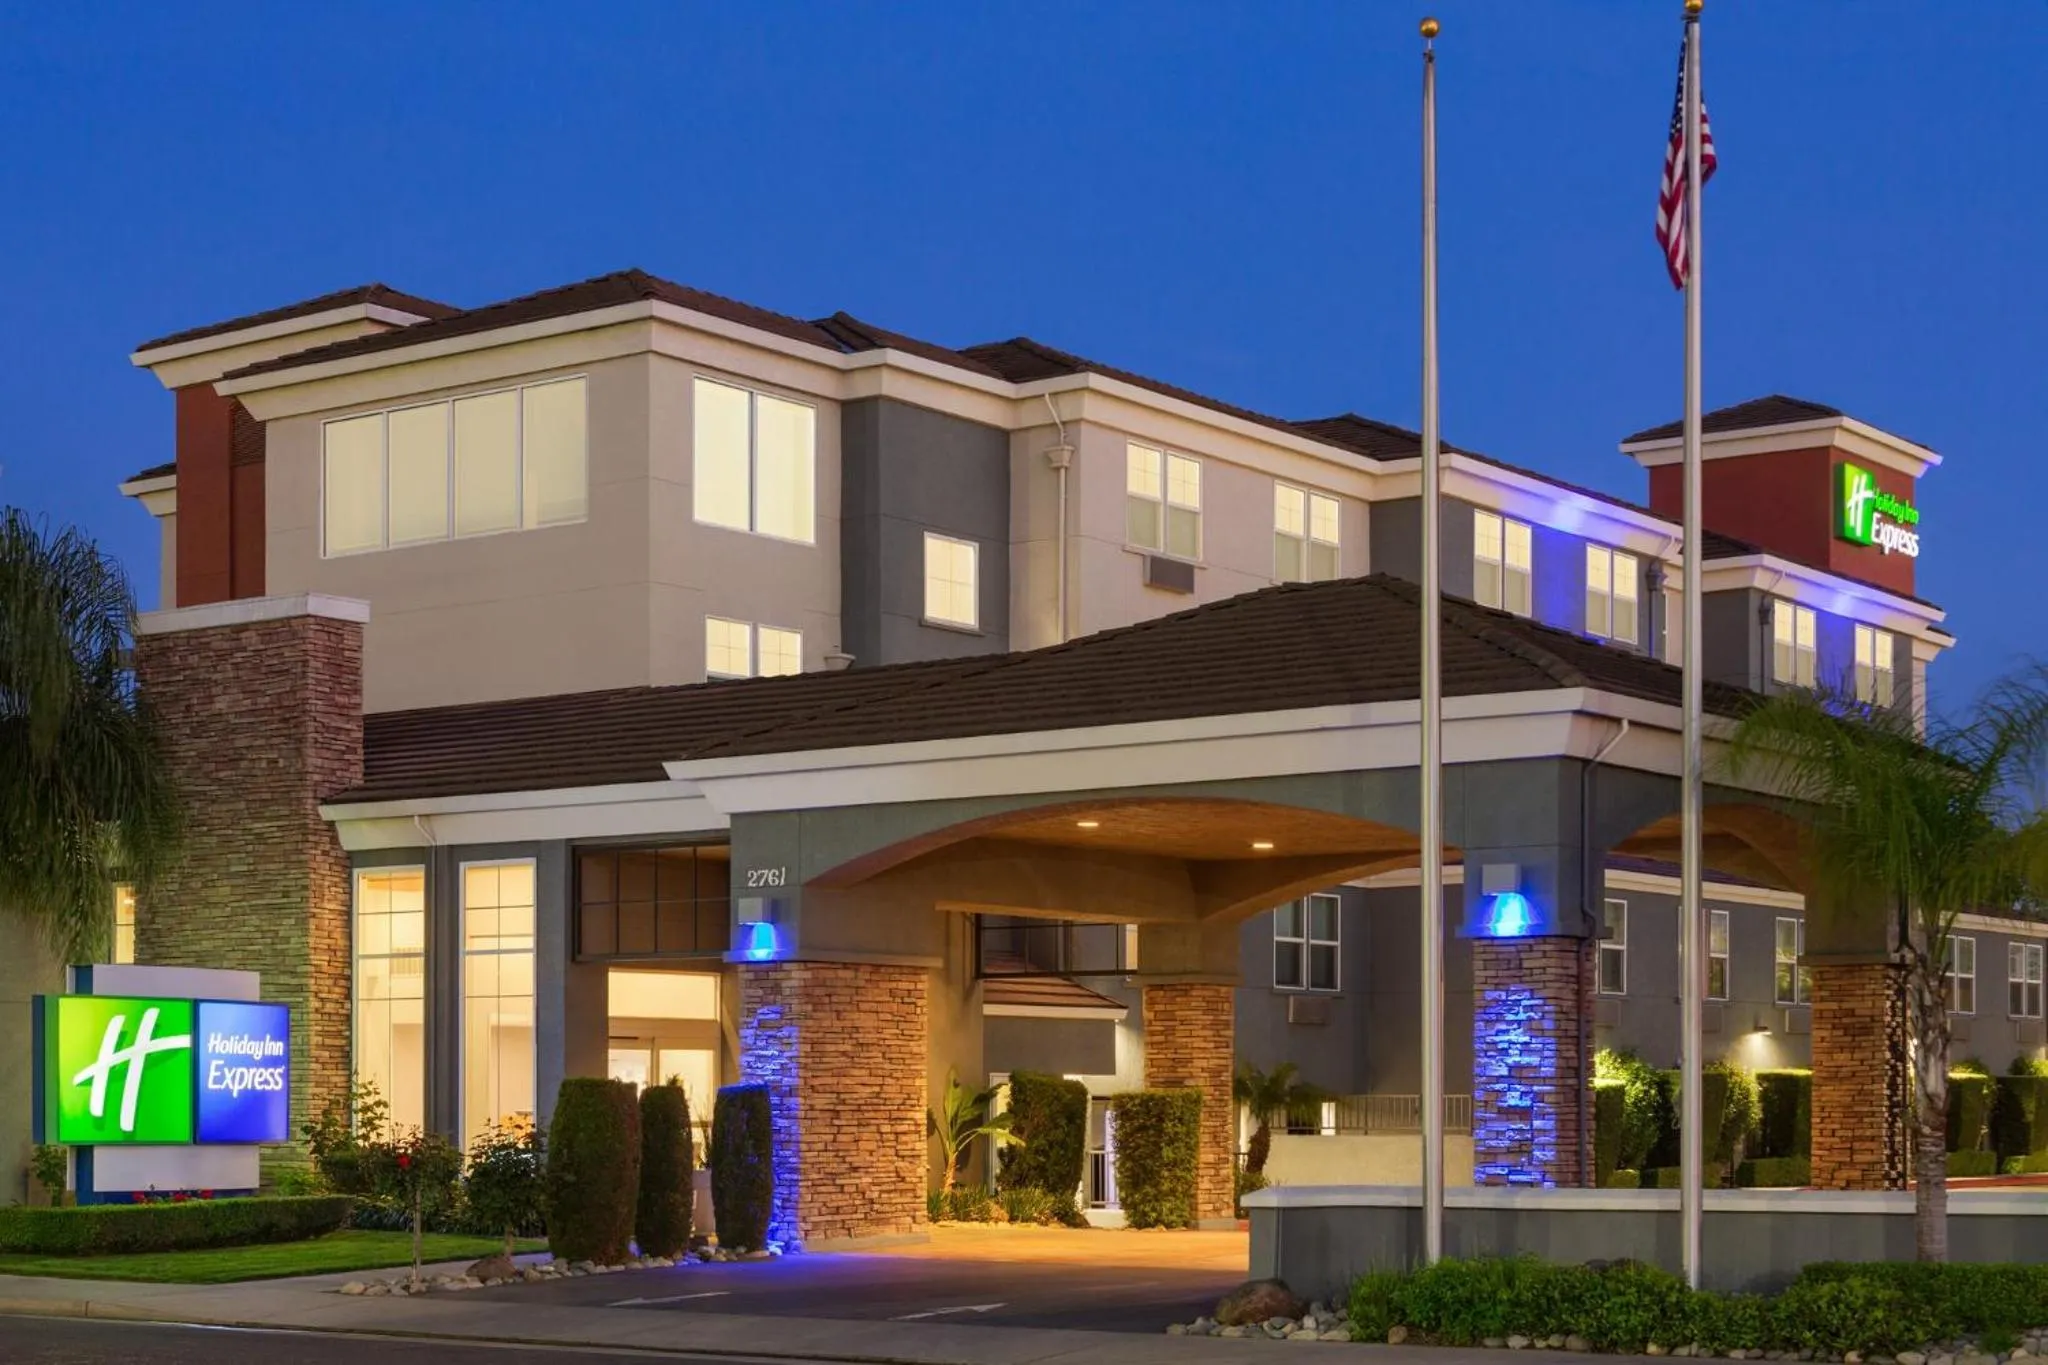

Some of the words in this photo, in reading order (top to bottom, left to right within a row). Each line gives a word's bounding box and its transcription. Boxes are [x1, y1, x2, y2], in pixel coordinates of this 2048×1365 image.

[1871, 511, 1920, 557] Express
[747, 866, 786, 887] 2761
[207, 1032, 264, 1060] Holiday
[264, 1033, 284, 1056] Inn
[207, 1060, 284, 1098] Express
